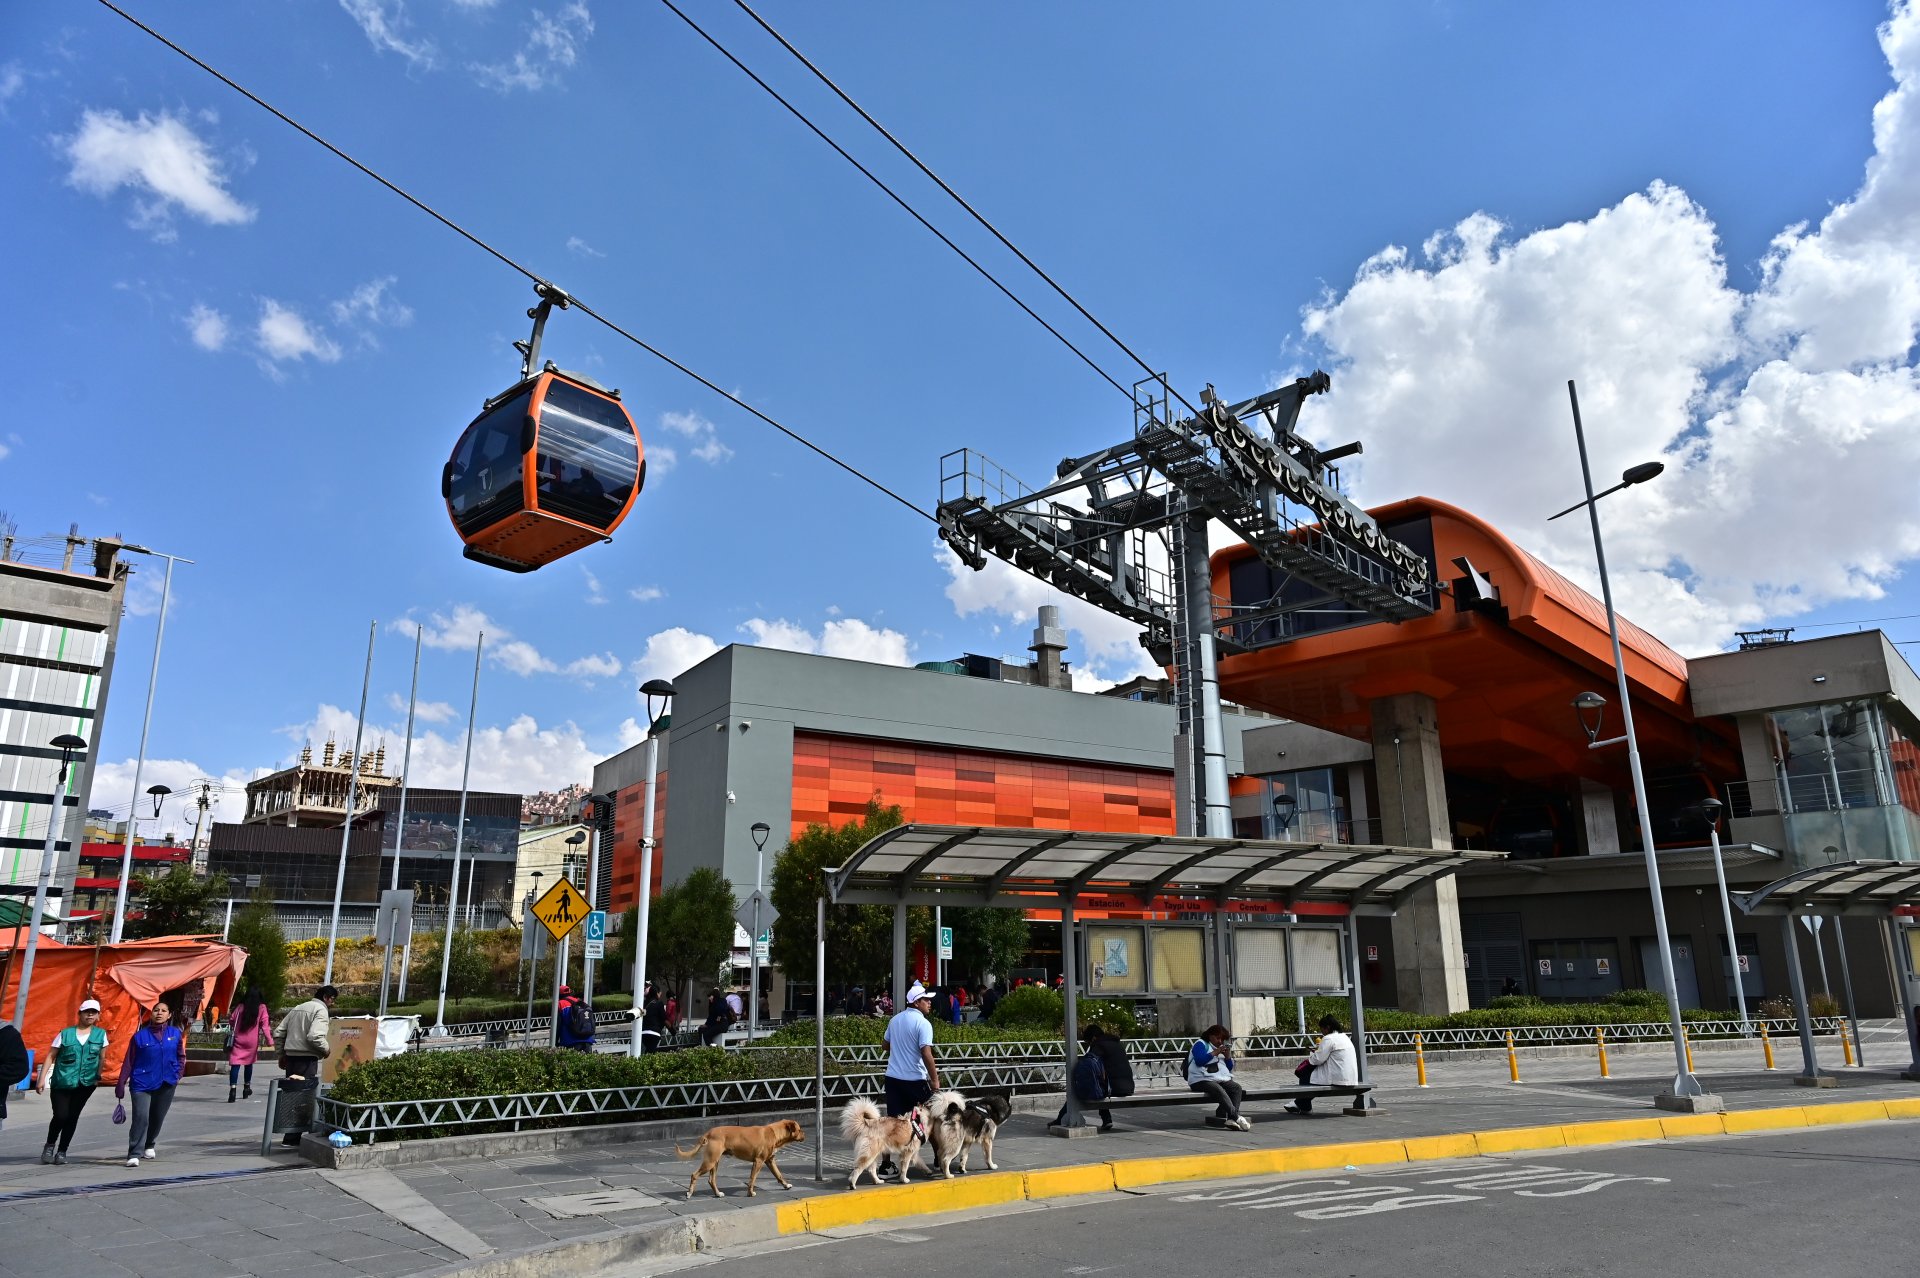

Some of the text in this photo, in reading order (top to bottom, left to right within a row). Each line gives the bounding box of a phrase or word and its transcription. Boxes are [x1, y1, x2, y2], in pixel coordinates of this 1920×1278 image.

[1088, 898, 1268, 912] Estación Taypi Uta Central
[1168, 1179, 1487, 1220] BUS
